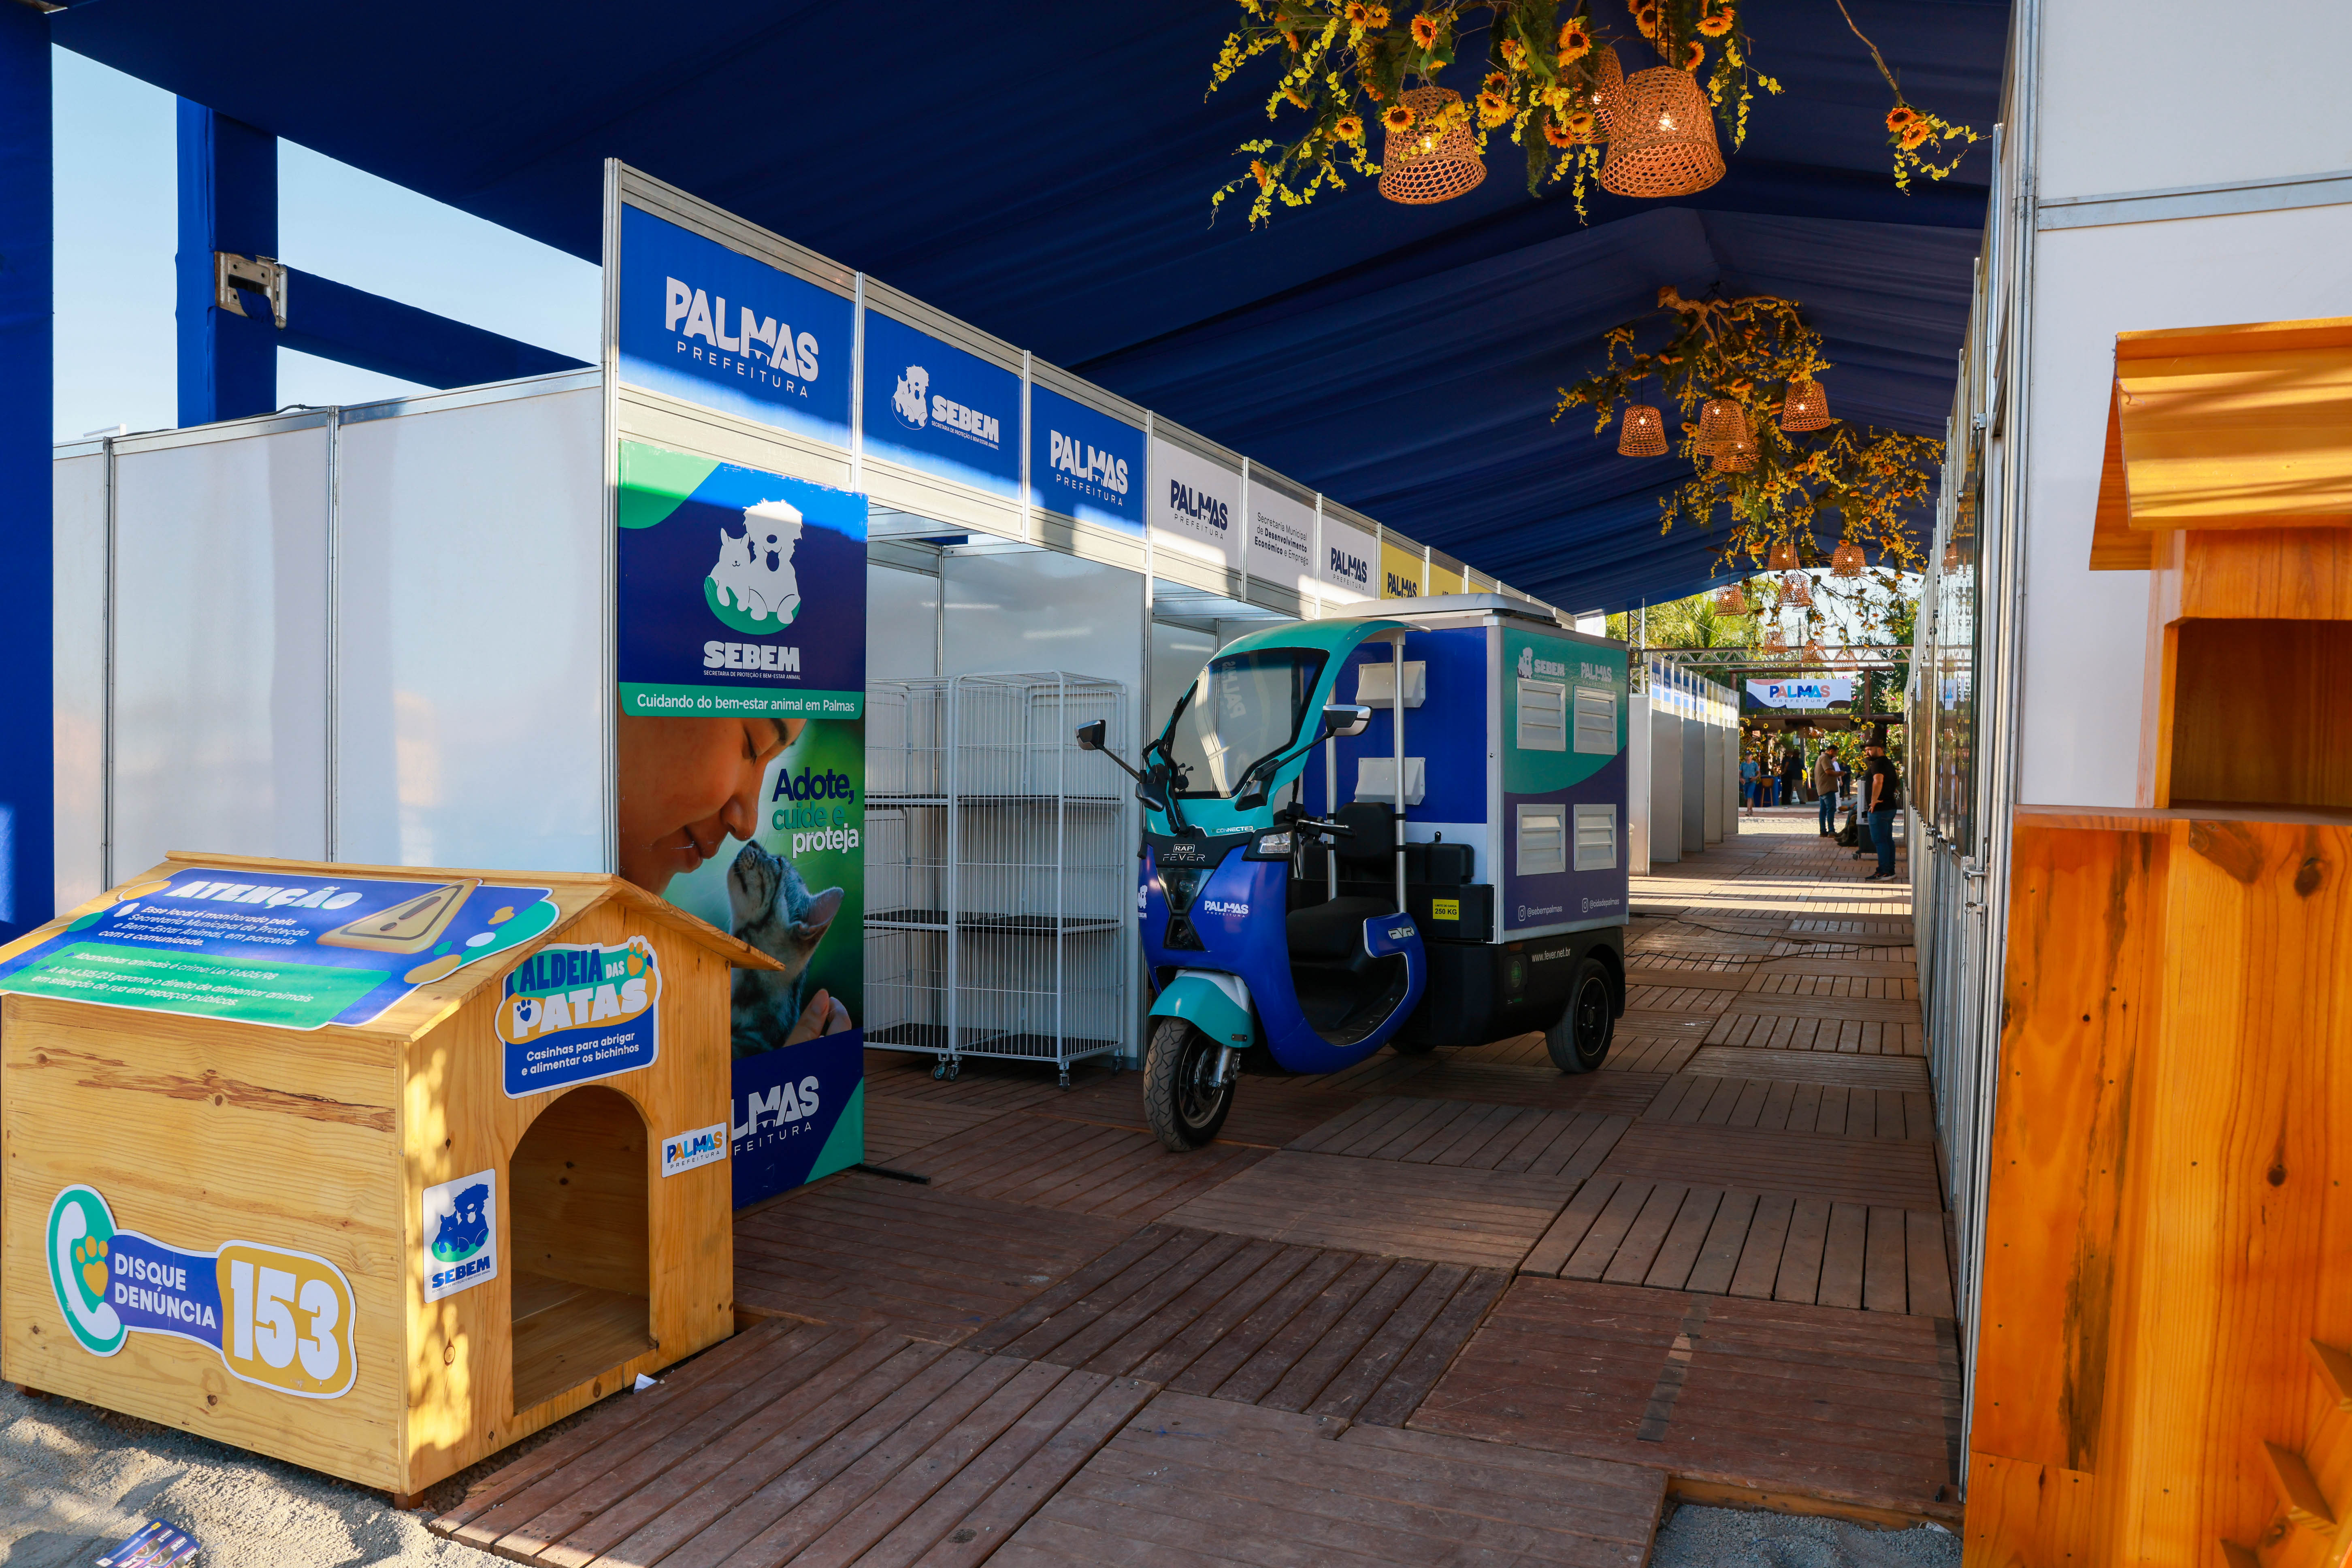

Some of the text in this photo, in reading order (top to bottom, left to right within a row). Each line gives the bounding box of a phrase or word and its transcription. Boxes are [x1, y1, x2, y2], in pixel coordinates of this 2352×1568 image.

[665, 276, 818, 381] PALMAS
[677, 341, 807, 398] PREFEITURA
[932, 395, 999, 443] SEBEM
[931, 421, 950, 432] SECRETARIA
[955, 430, 970, 439] PROTEÇÃO
[980, 438, 988, 446] ESTAR
[989, 442, 999, 450] ANIMAL
[1050, 429, 1128, 494] PALMAS
[1057, 474, 1123, 507] PREFEITURA
[1170, 479, 1228, 531] PALMAS
[1174, 513, 1223, 540] PREFEITURA
[1257, 512, 1307, 541] Secretaria Municipal
[1257, 524, 1307, 553] de Desenvolvimento
[1255, 536, 1283, 555] Econômico
[1289, 550, 1308, 566] Emprego
[1331, 547, 1367, 584] PALMAS
[1333, 573, 1365, 591] PREFEITURA
[1387, 572, 1417, 598] PALMAS
[703, 641, 800, 672] SEBEM
[1534, 659, 1565, 677] SEBEM
[1581, 662, 1612, 683] PALMAS
[637, 694, 854, 712] Cuidando do bem-estar animal em Palmas
[1770, 685, 1830, 698] PALMAS
[772, 767, 854, 805] Adote,
[772, 801, 845, 830] cuide e
[792, 823, 859, 859] proteja
[1163, 853, 1205, 862] FEVER
[162, 881, 363, 910] ATENÇÃO
[1204, 900, 1249, 914] PALMAS
[1589, 898, 1619, 909] @cidadepalmas
[128, 914, 186, 925] Secretaria
[183, 919, 241, 930] Municipal
[256, 925, 310, 937] Proteção
[166, 908, 194, 916] local
[202, 912, 269, 923] monitorado
[1527, 905, 1562, 917] @sebempalmas
[121, 922, 183, 934] Bem-Estar
[179, 929, 226, 939] Animal,
[241, 935, 298, 945] parceria
[132, 934, 204, 946] comunidade.
[72, 952, 130, 965] Abandonar
[128, 959, 171, 969] animais
[177, 964, 213, 973] crime!
[228, 969, 279, 980] 9.605/98
[1532, 947, 1571, 962] www.fever.net.br
[55, 967, 75, 975] lei
[108, 974, 153, 985] garante
[161, 978, 197, 989] direito
[196, 982, 212, 991] de
[211, 985, 267, 997] alimentar
[265, 992, 314, 1002] animais
[519, 949, 625, 993] ALDEIA DAS
[49, 977, 95, 988] situação
[145, 990, 192, 1000] espaços
[187, 994, 239, 1006] públicos.
[513, 978, 648, 1039] PATAS
[526, 1033, 635, 1061] Casinhas para abrigar
[530, 1056, 580, 1074] alimentar
[582, 1054, 593, 1063] os
[595, 1044, 639, 1060] bichinhos
[731, 1076, 819, 1141] LMAS
[667, 1131, 722, 1163] PALMAS
[734, 1122, 811, 1156] FEITURA
[670, 1150, 720, 1169] PREFEITURA
[115, 1253, 186, 1291] DISQUE
[432, 1255, 490, 1288] SEBEM
[115, 1280, 217, 1329] DENÚNCIA
[230, 1259, 339, 1380] 153
